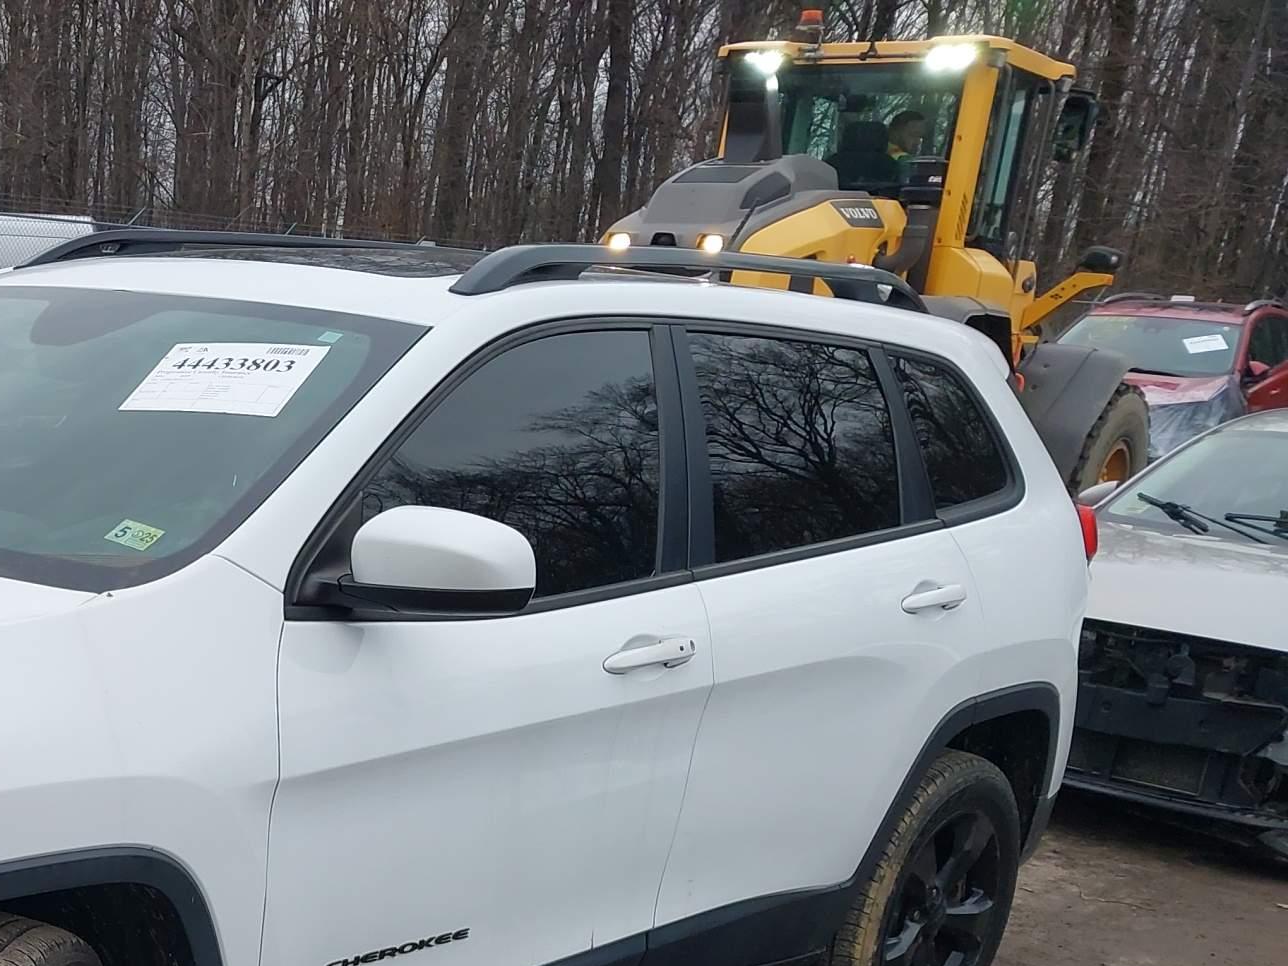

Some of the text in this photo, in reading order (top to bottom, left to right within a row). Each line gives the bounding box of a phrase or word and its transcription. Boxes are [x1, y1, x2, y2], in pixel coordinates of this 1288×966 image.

[840, 207, 878, 219] VOLVO
[172, 357, 296, 373] 44433803
[114, 526, 132, 538] 5
